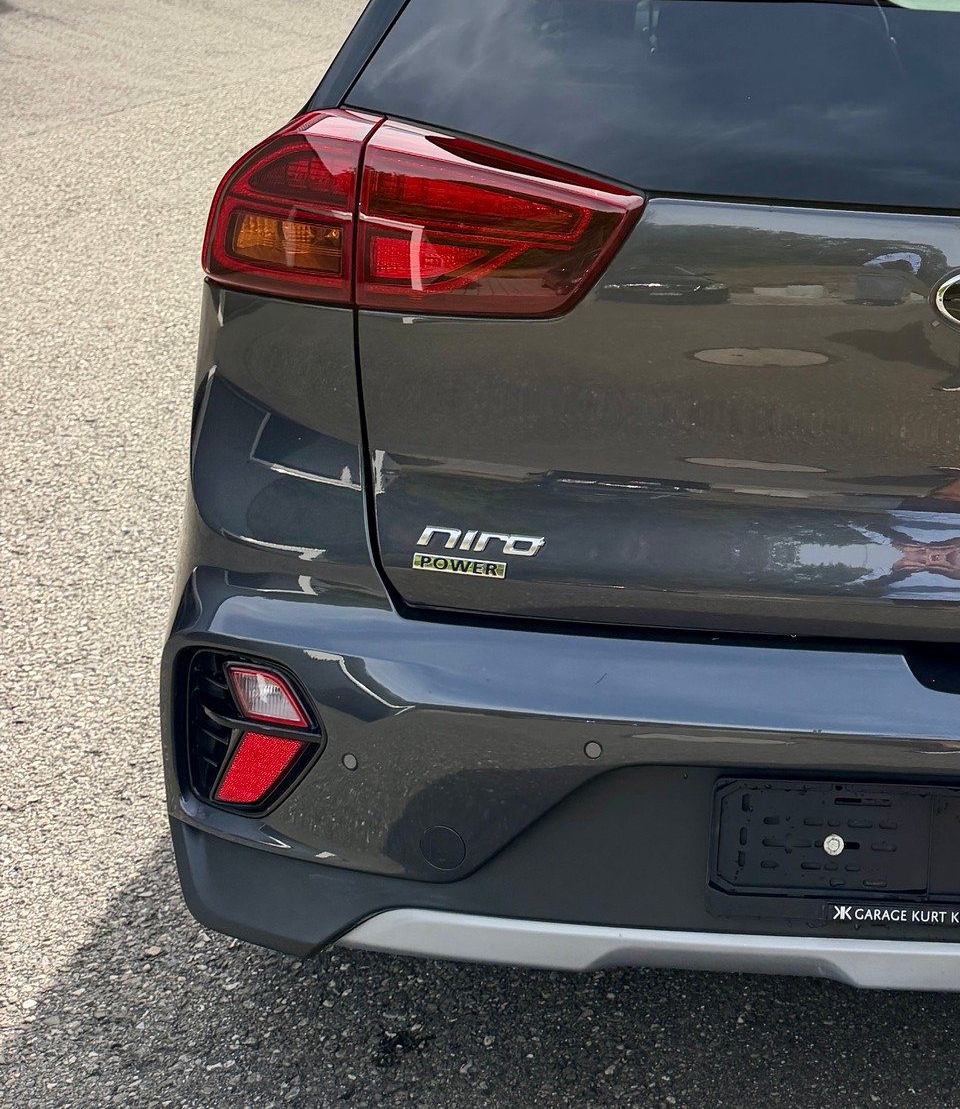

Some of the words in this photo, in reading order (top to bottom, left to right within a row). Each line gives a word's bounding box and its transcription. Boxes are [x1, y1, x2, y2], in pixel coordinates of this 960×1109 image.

[419, 555, 499, 576] POWER
[854, 908, 908, 922] GARAGE
[911, 910, 948, 923] KURT
